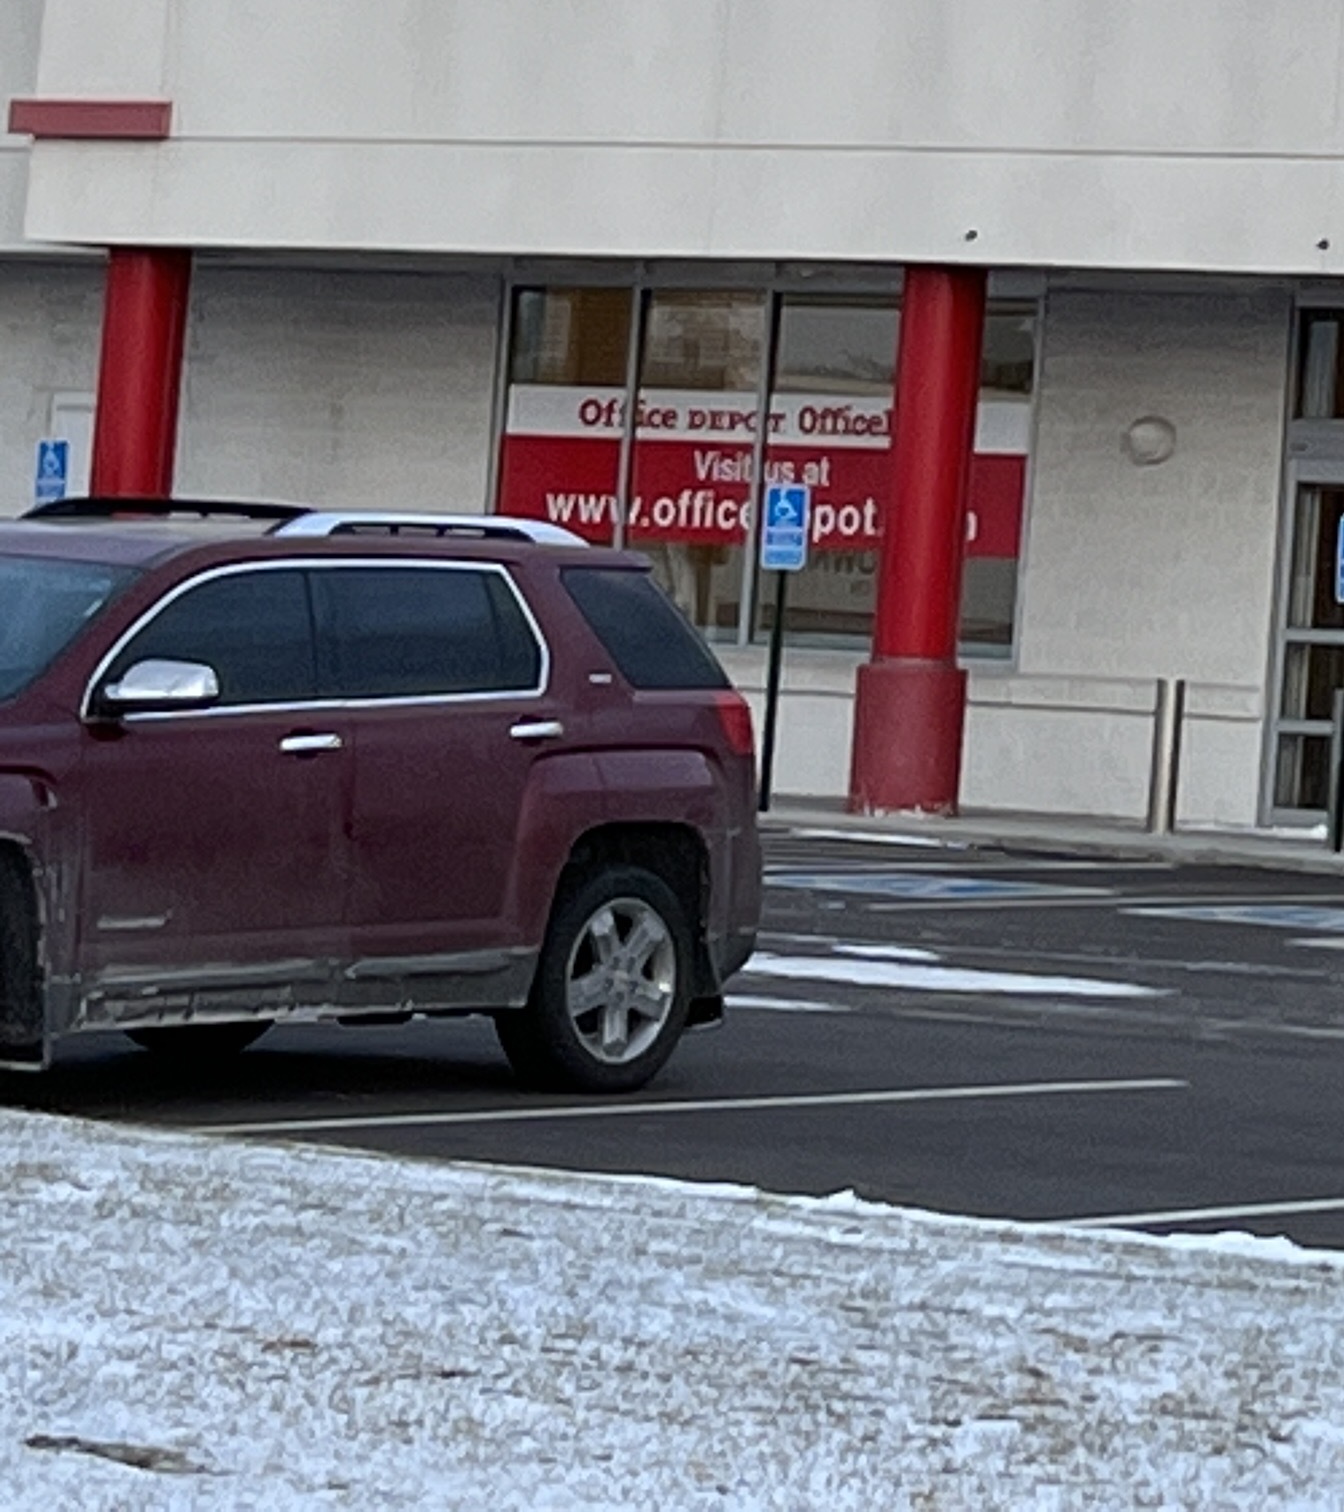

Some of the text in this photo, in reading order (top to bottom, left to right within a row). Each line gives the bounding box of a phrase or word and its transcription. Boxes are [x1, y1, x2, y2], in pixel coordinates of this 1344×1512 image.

[579, 398, 677, 428] Ofice
[798, 404, 893, 436] Office
[694, 450, 830, 487] Visit us at
